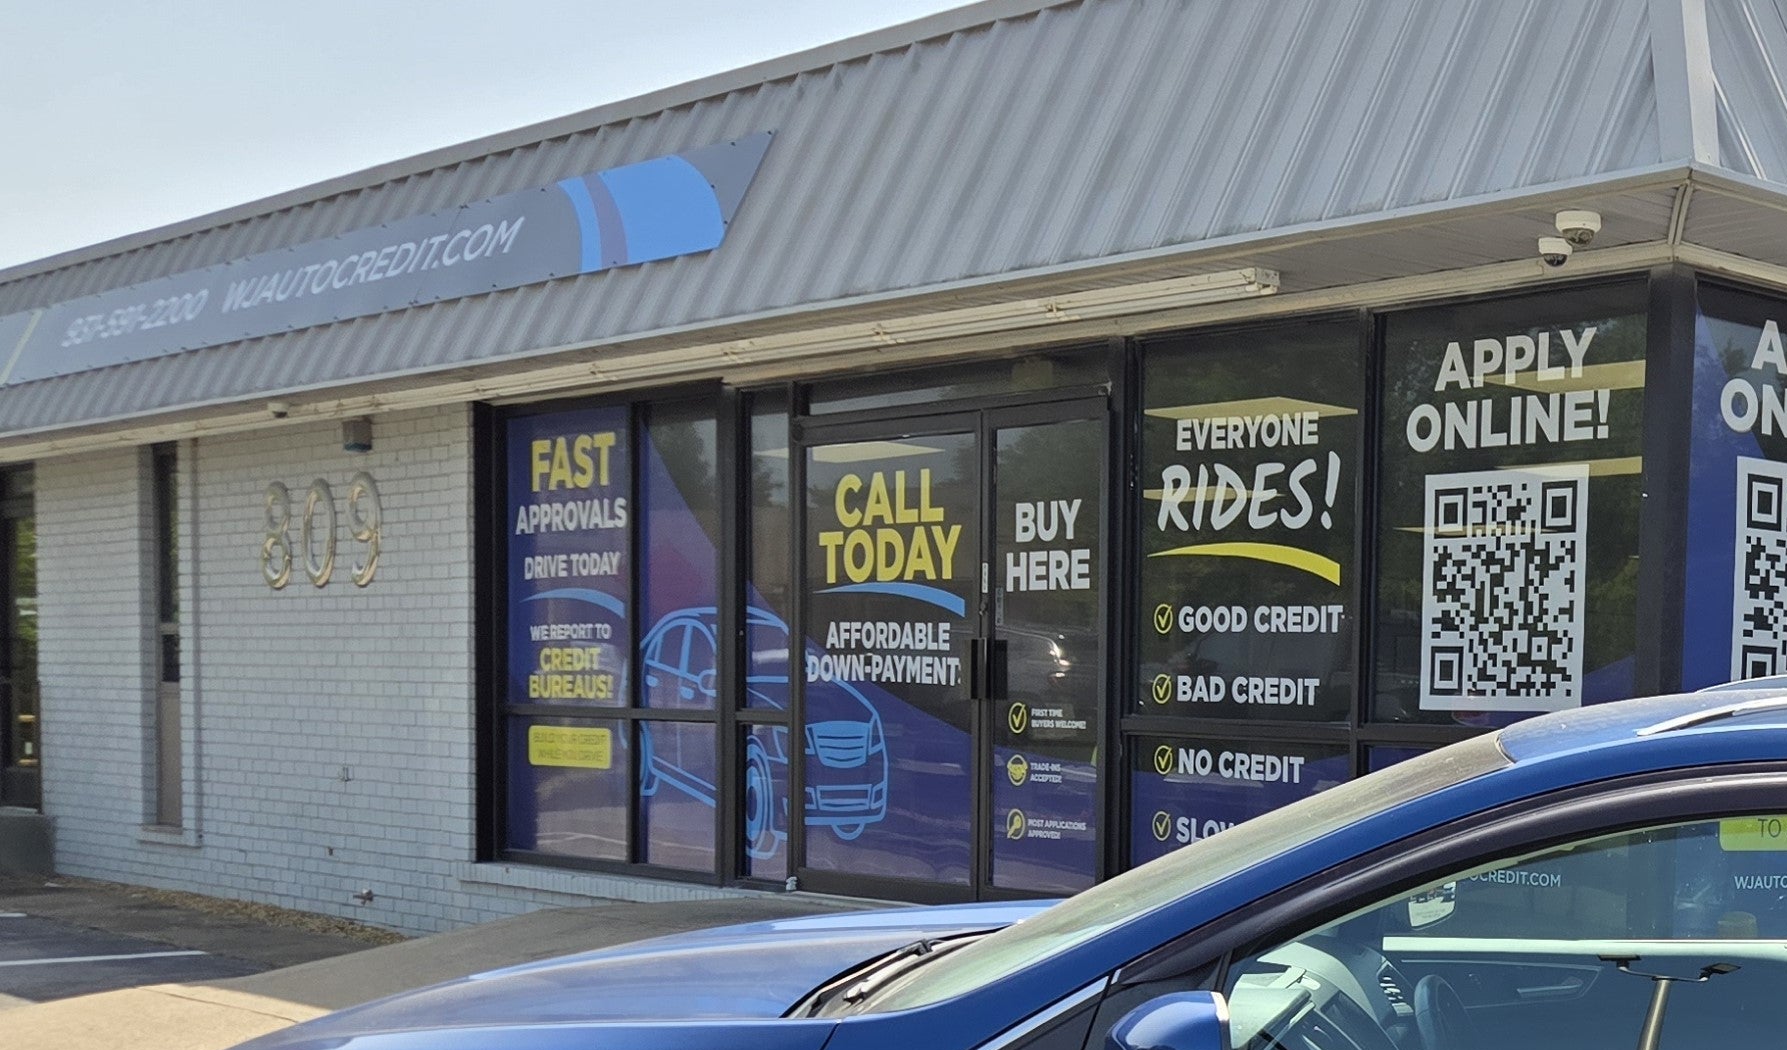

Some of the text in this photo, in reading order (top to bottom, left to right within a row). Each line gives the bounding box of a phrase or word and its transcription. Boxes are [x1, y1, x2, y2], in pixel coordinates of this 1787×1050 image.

[222, 216, 525, 313] WJAUTOCREDIT.COM
[1434, 326, 1598, 392] APPLY
[1176, 411, 1319, 451] EVERYONE
[1406, 389, 1611, 453] ONLINE!
[532, 432, 616, 492] FAST
[835, 468, 945, 528] CALL
[1157, 450, 1341, 532] RIDES!
[260, 471, 383, 590] 809
[515, 497, 628, 535] APPROVALS
[1015, 499, 1083, 543] BUY
[524, 551, 621, 580] DRIVE TODAY
[818, 524, 962, 584] TODAY
[1005, 548, 1091, 592] HERE
[530, 623, 612, 642] WE REPORT TO
[825, 621, 950, 650] AFFORDABLE
[1178, 604, 1343, 633] GOOD CREDIT
[540, 647, 601, 672] CREDIT
[806, 654, 961, 687] DOWN-PAYMENT
[529, 674, 614, 699] BUREAUS!
[1176, 675, 1320, 706] BAD CREDIT
[1178, 748, 1305, 784] NO CREDIT
[1757, 818, 1782, 838] TO
